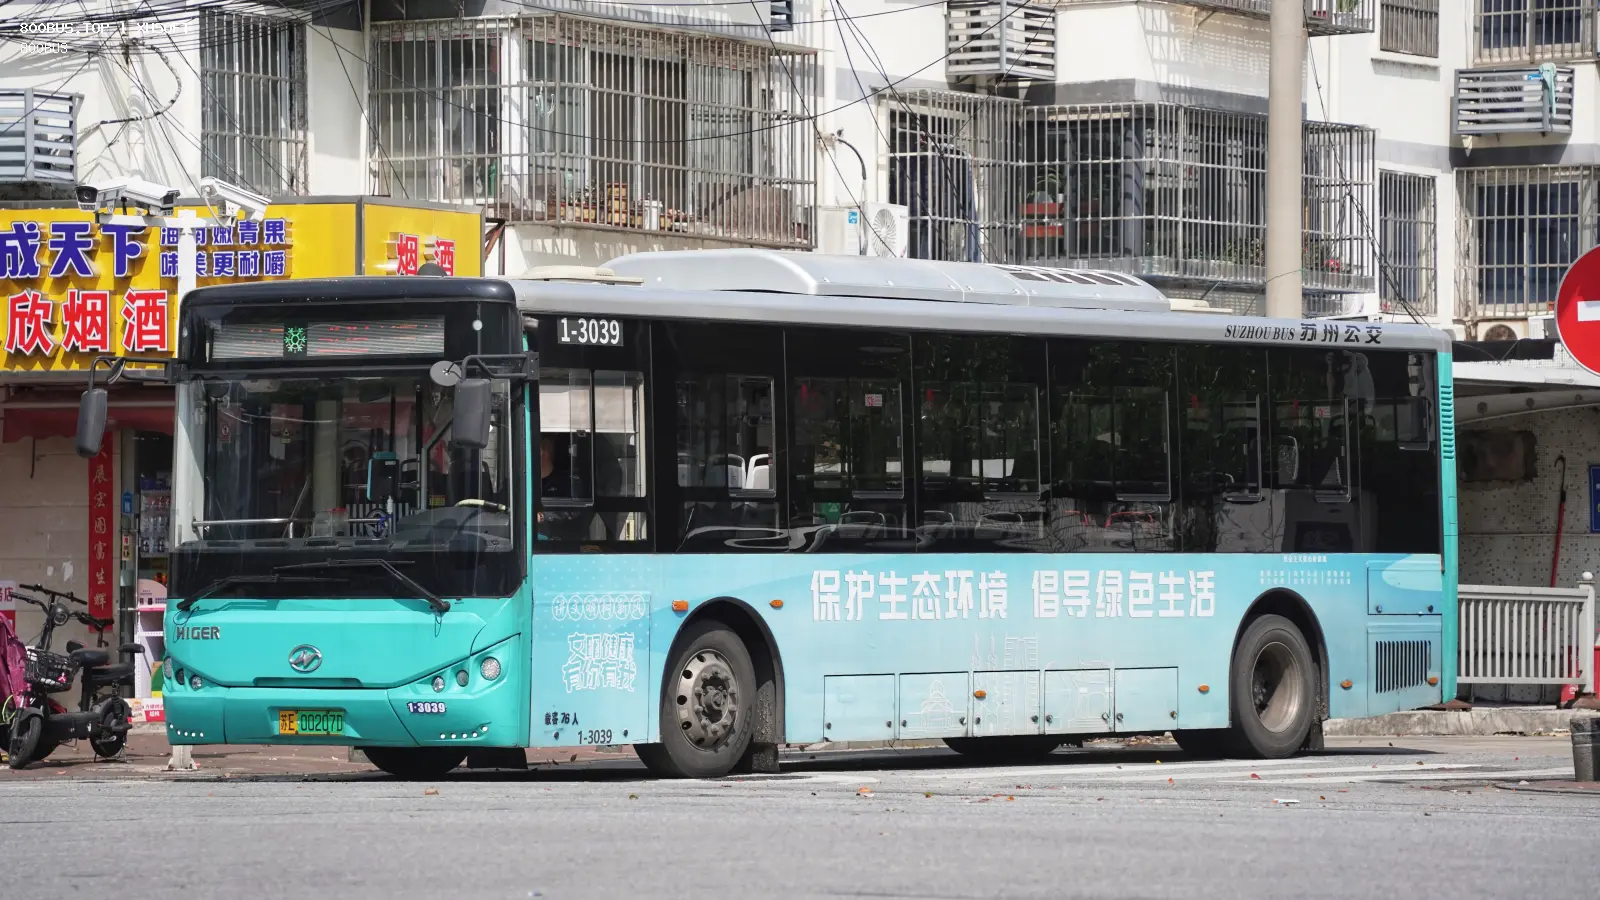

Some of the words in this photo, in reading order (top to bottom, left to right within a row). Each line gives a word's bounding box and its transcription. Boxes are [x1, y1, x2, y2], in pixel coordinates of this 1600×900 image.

[0, 221, 142, 278] 成天下
[396, 232, 456, 276] 烟酒
[4, 289, 168, 356] 欣烟酒
[560, 317, 621, 345] 1-3039
[1224, 324, 1272, 340] SUZHOU
[1272, 326, 1295, 341] BUS
[1300, 322, 1382, 345] 苏州公交
[810, 570, 1008, 621] 保护生态环境
[1031, 570, 1216, 618] 倡导绿色生活
[176, 626, 220, 641] HIGER
[300, 714, 343, 732] 00207D
[561, 712, 570, 725] 76
[572, 712, 579, 726] 人
[577, 729, 613, 745] 1-3039
